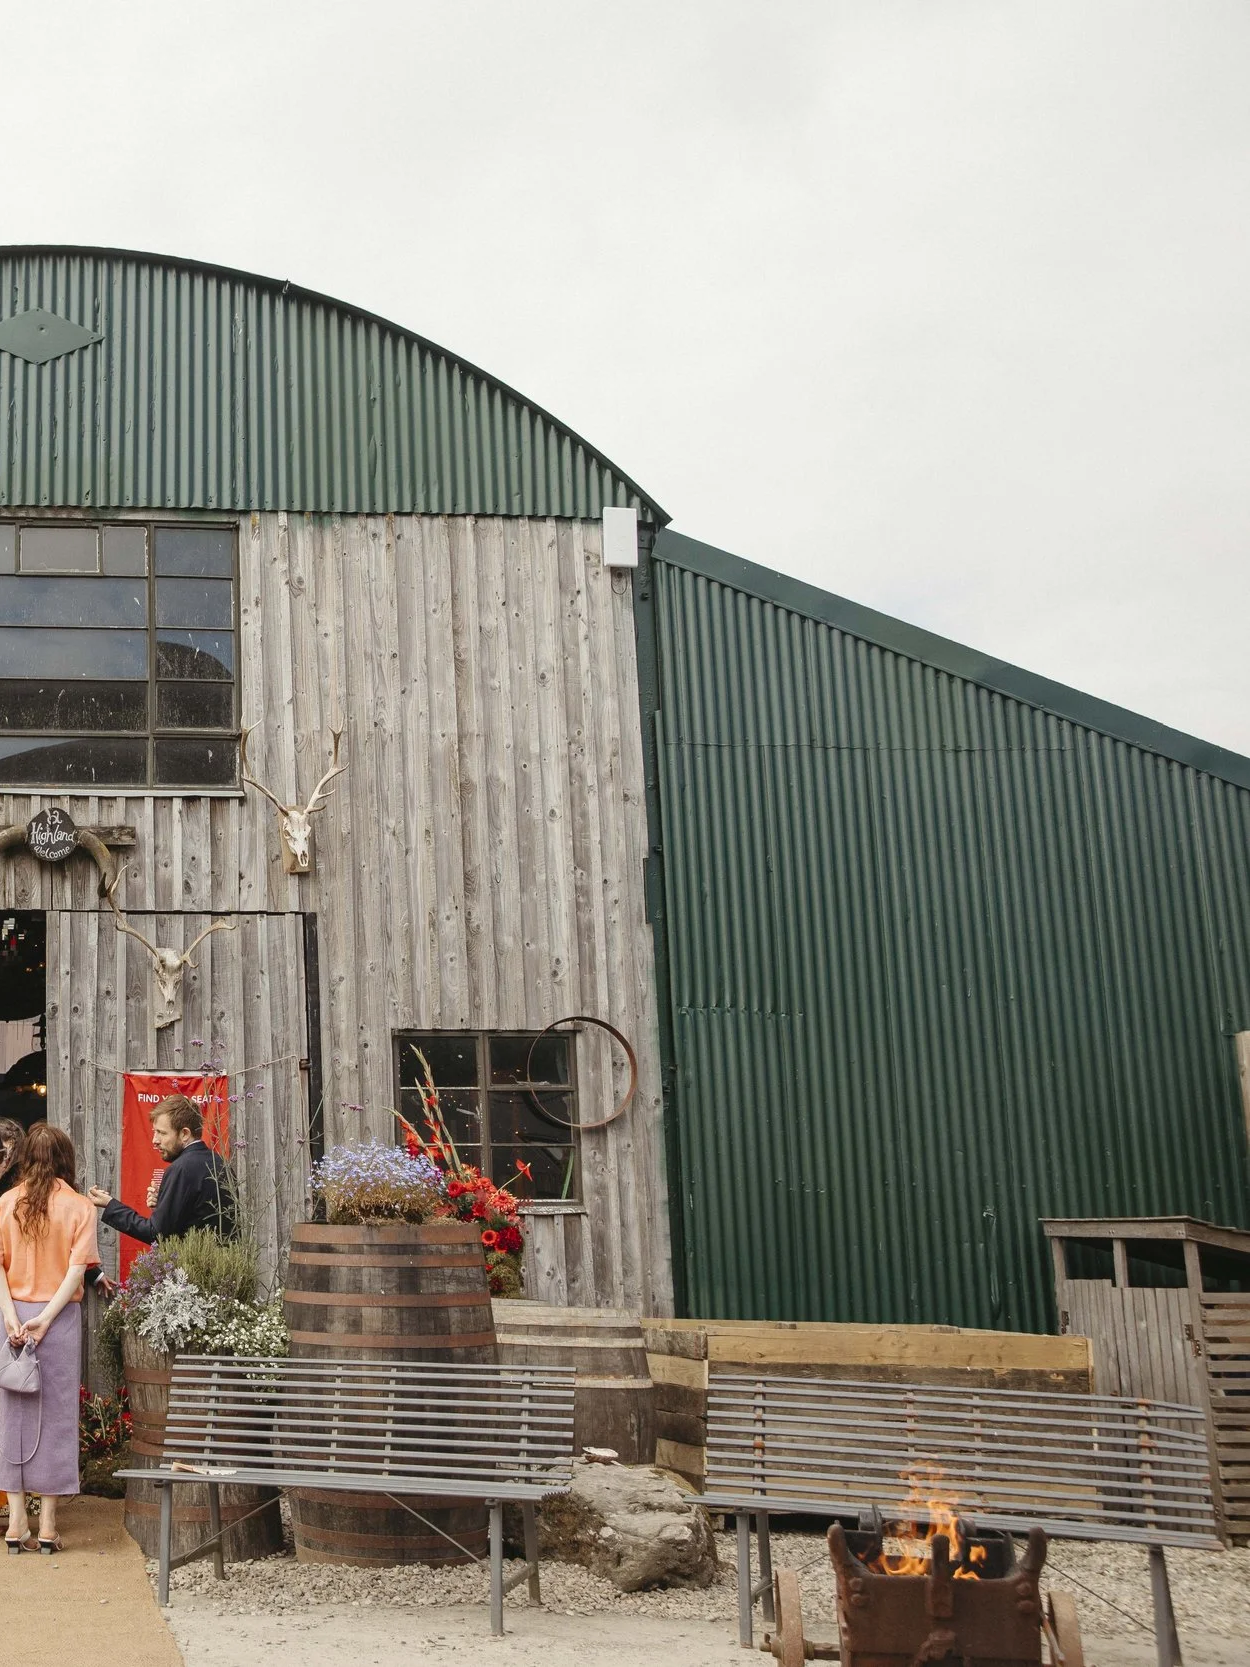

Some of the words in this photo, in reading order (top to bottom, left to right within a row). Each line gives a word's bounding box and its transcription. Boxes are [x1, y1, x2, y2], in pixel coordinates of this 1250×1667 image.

[30, 822, 76, 845] Highland
[138, 1094, 160, 1103] FIND
[191, 1095, 213, 1104] SEAT
